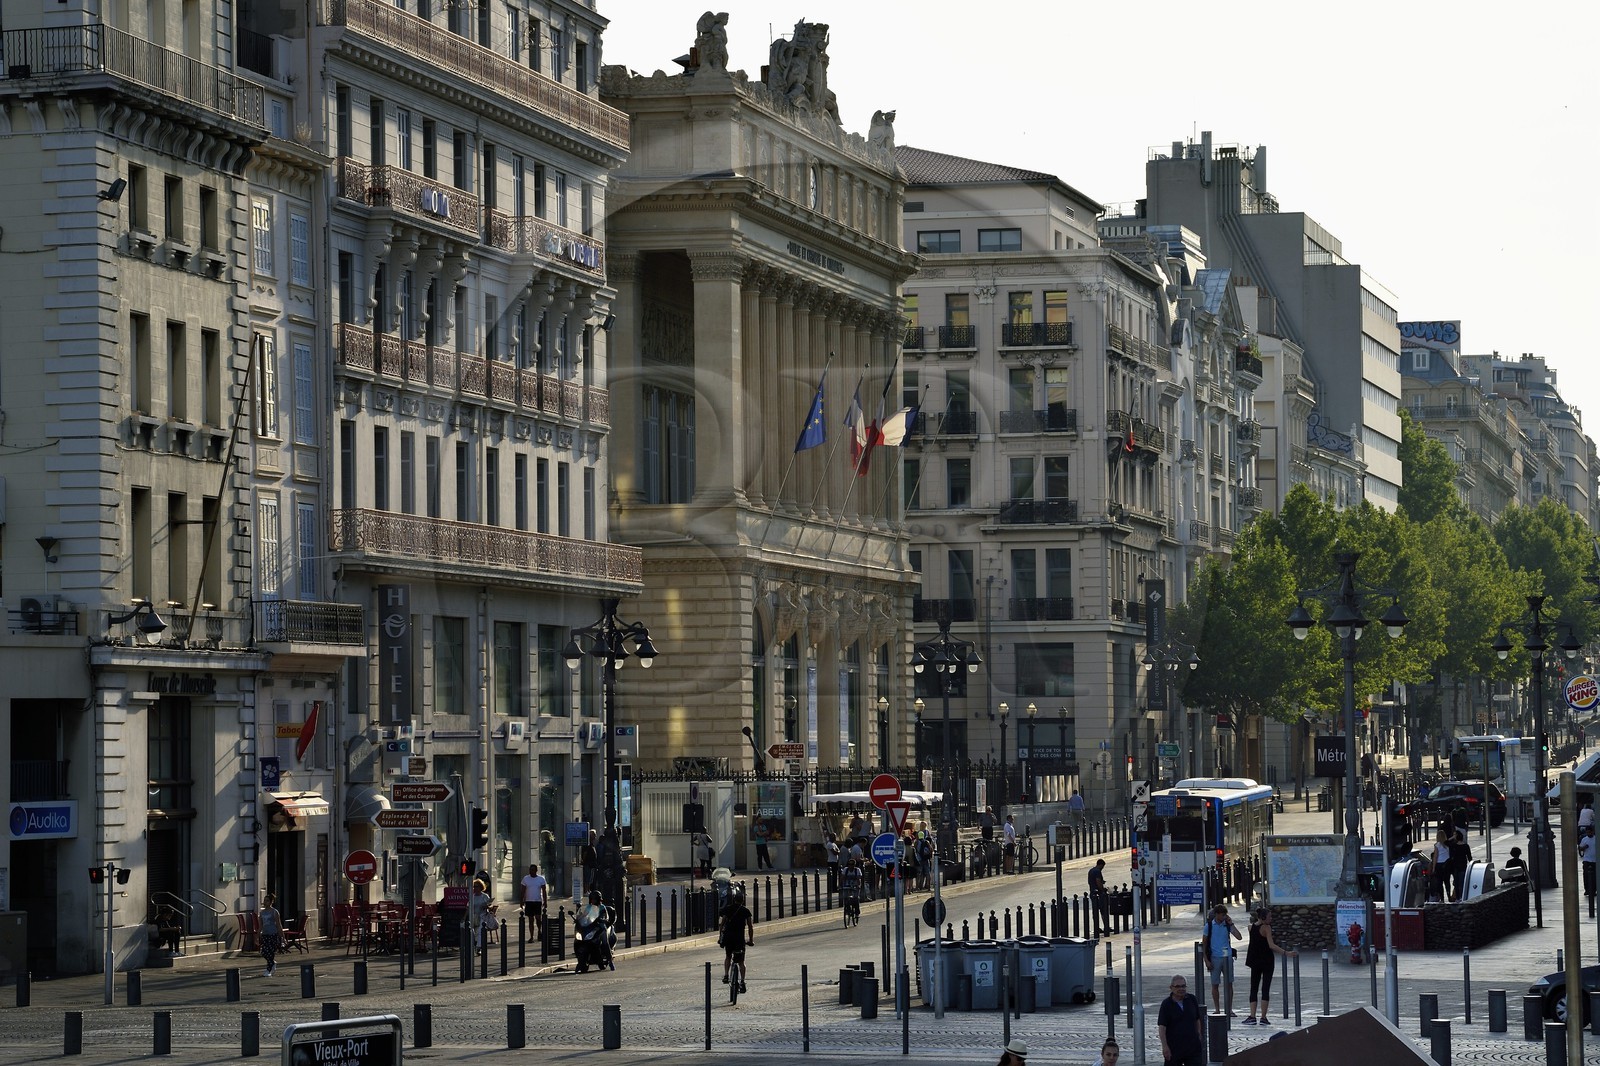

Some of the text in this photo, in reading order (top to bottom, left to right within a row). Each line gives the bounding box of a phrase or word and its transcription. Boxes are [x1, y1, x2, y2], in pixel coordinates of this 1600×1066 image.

[382, 588, 407, 723] HOTEL
[147, 671, 216, 694] Eaux de Marseille
[1567, 680, 1597, 703] BURGER KING
[277, 726, 301, 734] Tabac
[28, 811, 68, 829] Audika
[314, 1038, 369, 1061] Vieux-Port
[347, 1058, 360, 1066] Ville
